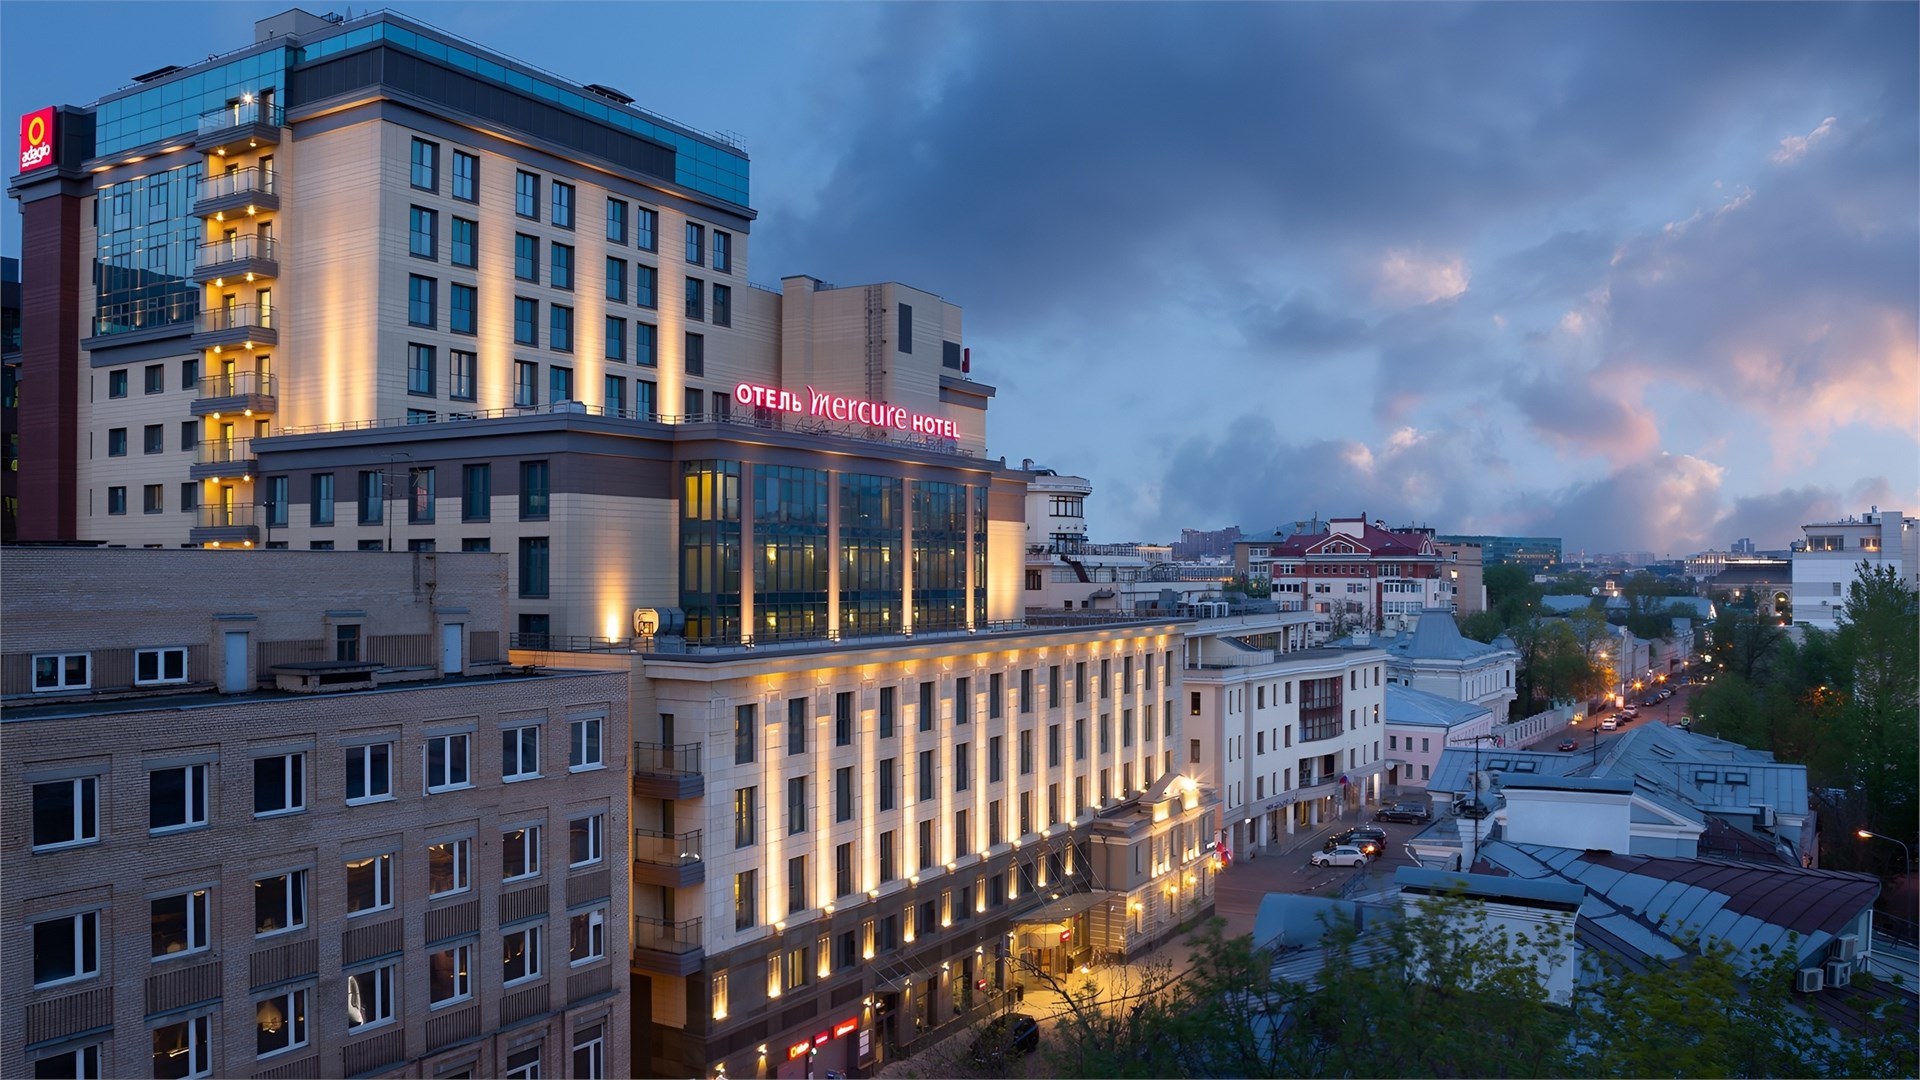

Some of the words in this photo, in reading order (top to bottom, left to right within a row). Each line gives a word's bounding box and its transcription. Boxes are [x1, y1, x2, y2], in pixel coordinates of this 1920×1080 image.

[22, 142, 50, 162] adagio
[736, 383, 802, 412] ОТЕЛЬ
[913, 414, 961, 438] HOTEL
